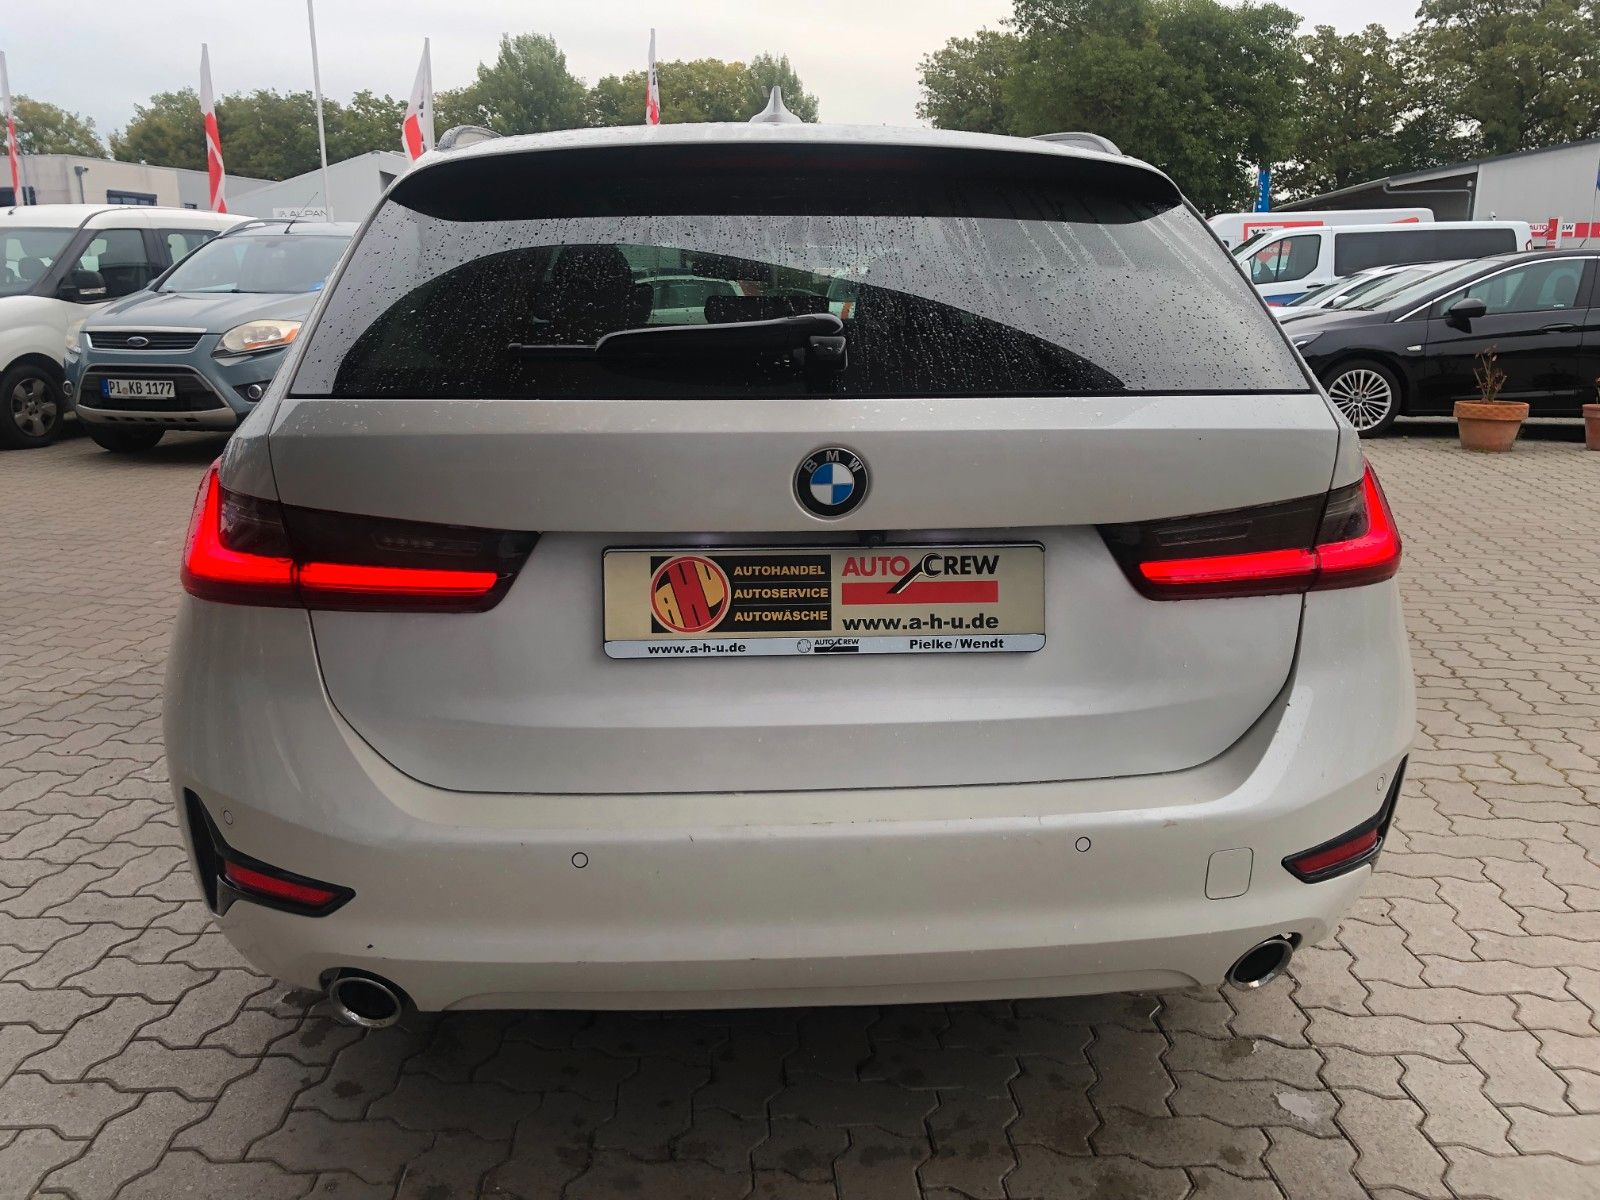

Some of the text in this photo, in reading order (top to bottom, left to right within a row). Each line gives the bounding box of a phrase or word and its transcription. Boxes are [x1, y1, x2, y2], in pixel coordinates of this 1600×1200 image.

[109, 381, 173, 395] PI KB 1177
[803, 450, 863, 474] BMW
[733, 565, 826, 576] AUTOHANDEL
[842, 552, 1000, 578] AUTO CREW
[733, 587, 829, 599] AUTOSERVICE
[734, 609, 828, 622] AUTOWÄSCHE
[841, 612, 999, 631] www.a-h-u.de
[648, 642, 747, 654] www.a-h-u.de
[814, 638, 835, 646] AUTO
